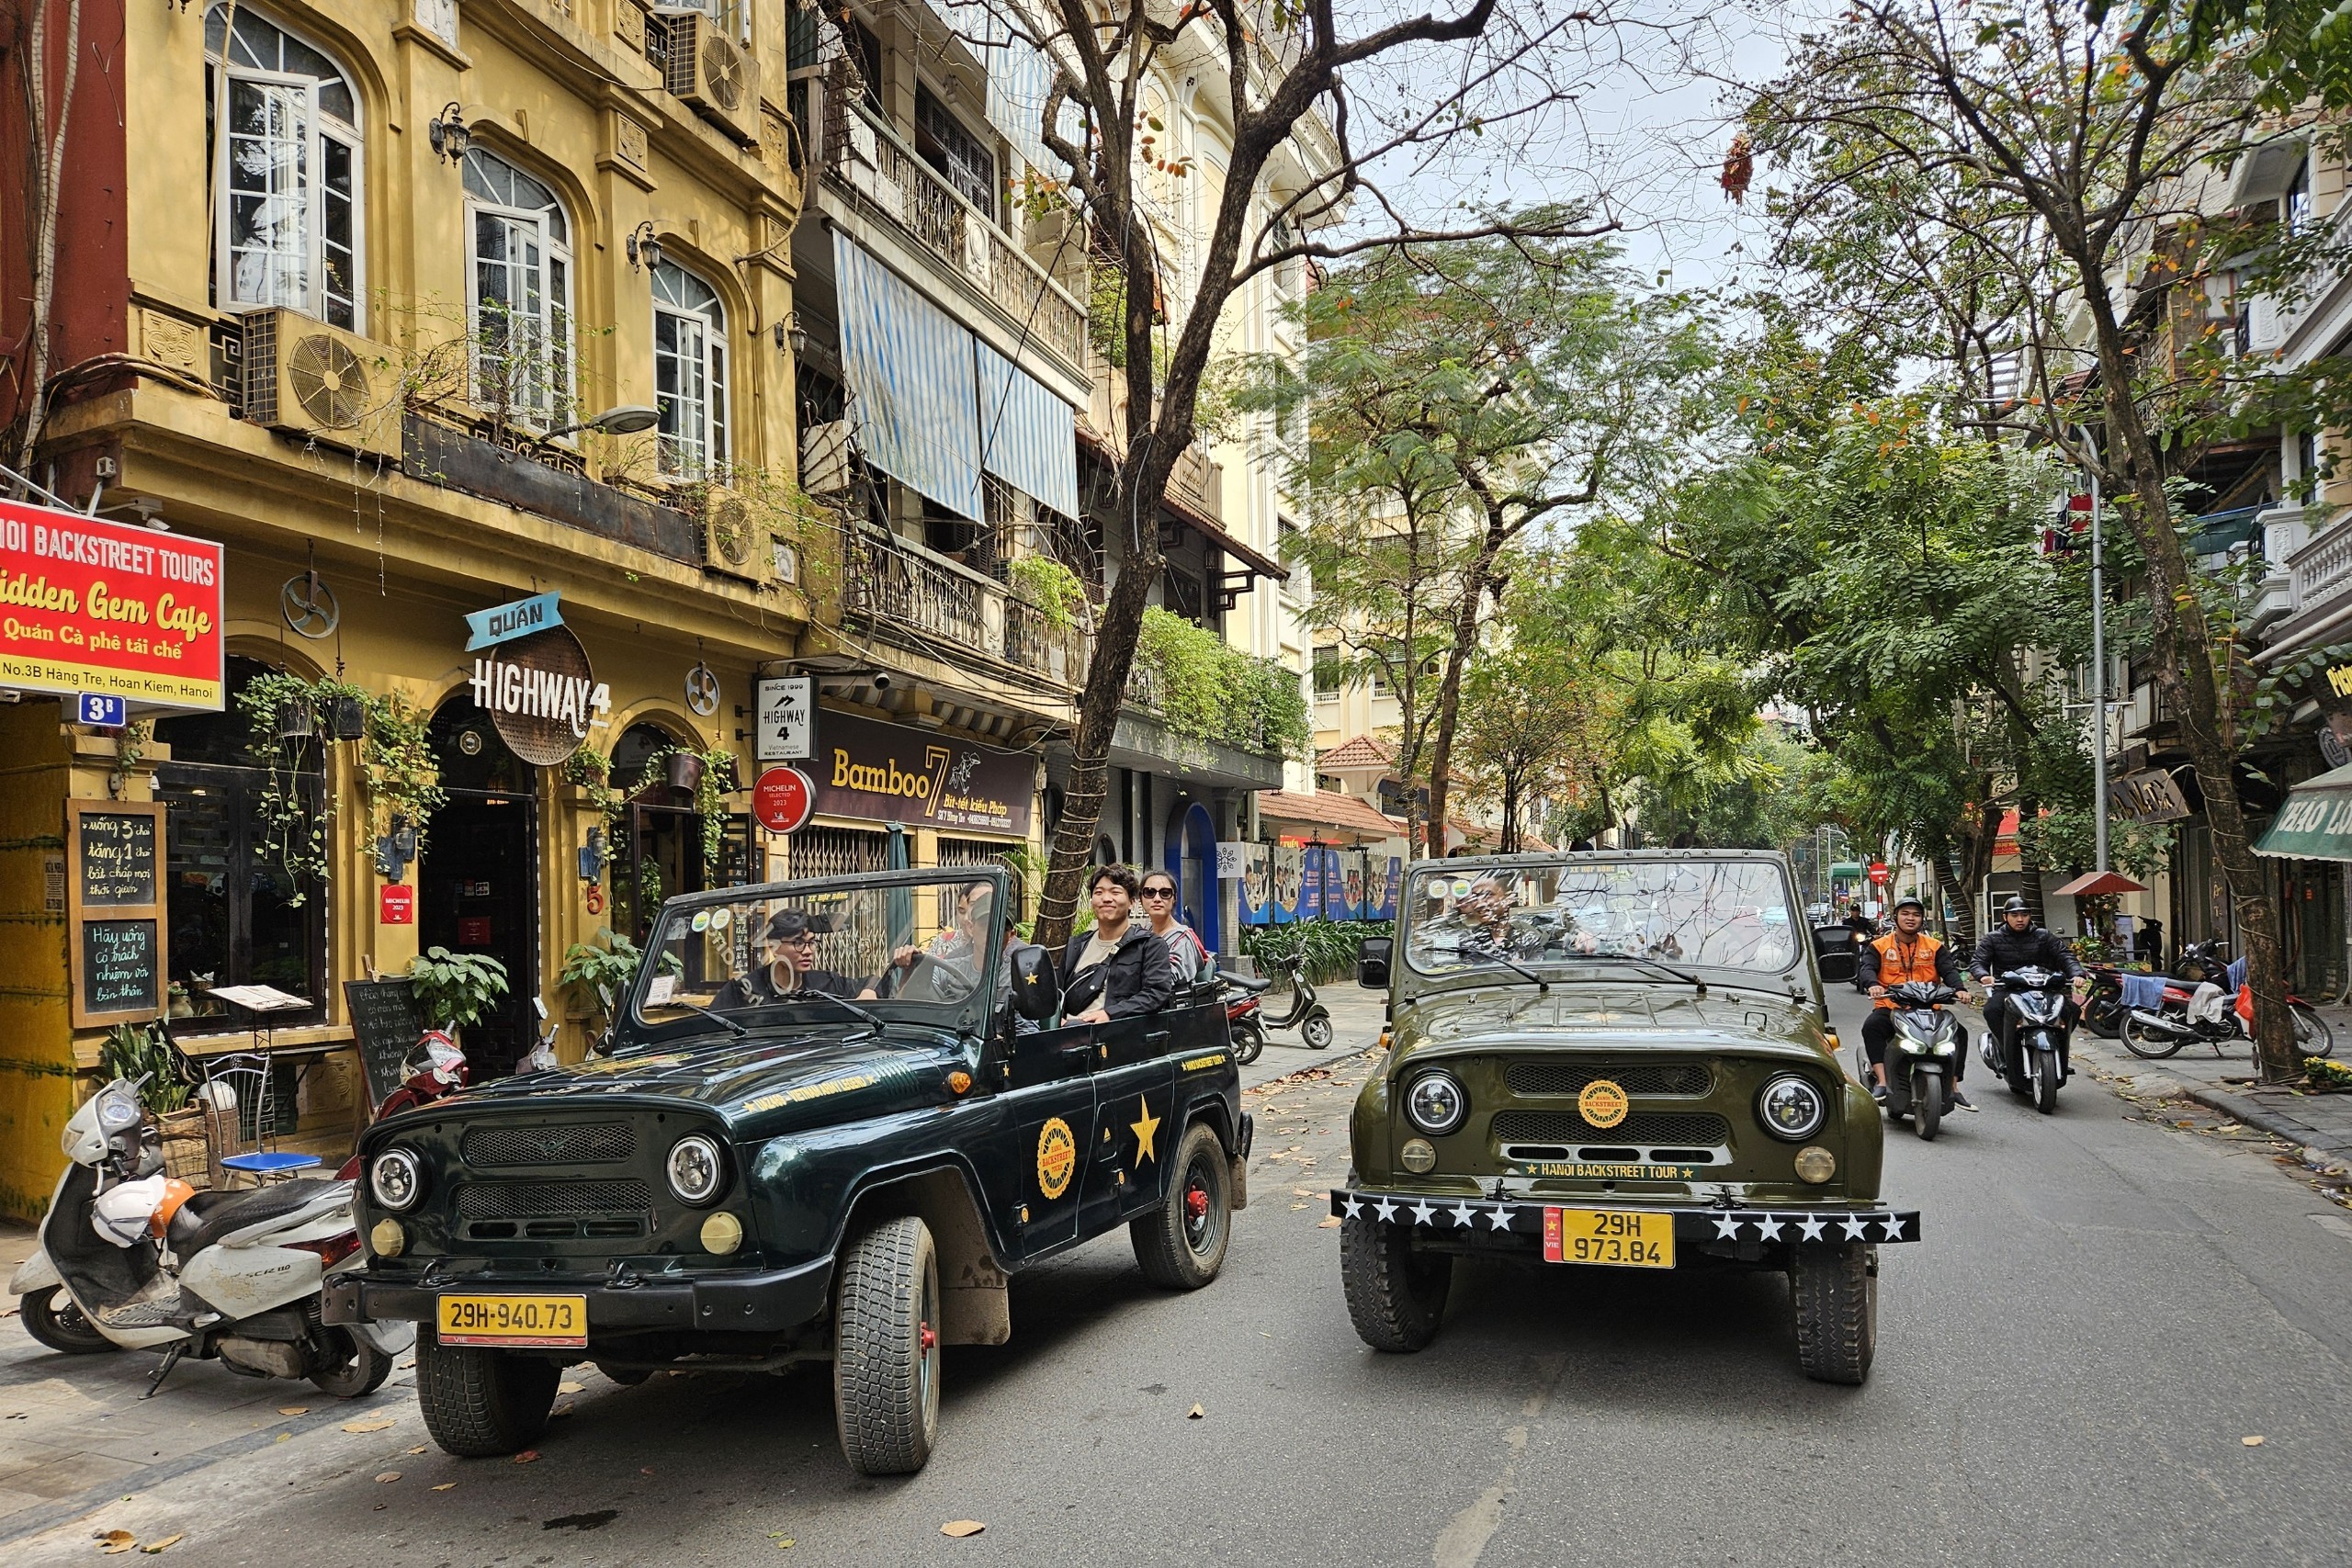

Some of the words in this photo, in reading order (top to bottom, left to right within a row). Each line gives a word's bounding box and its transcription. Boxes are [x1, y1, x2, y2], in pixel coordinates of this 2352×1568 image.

[34, 525, 154, 576] BACKSTREET
[159, 548, 214, 587] TOURS
[0, 569, 80, 614] idden
[86, 581, 150, 626] Gem
[156, 592, 213, 642] Cafe
[489, 602, 543, 637] QUÁN
[4, 617, 54, 642] Quán
[59, 626, 85, 646] Cà
[89, 631, 121, 652] phê
[126, 636, 149, 656] tái
[153, 641, 183, 660] chế
[3, 661, 42, 679] No.3B
[46, 667, 79, 686] Hàng
[83, 671, 106, 688] Tre,
[109, 675, 141, 690] Hoan
[144, 680, 176, 695] Kiem,
[180, 683, 213, 699] Hanoi
[764, 683, 786, 692] SINCE
[469, 658, 591, 739] HIGHWAY
[590, 682, 612, 715] 4
[763, 709, 806, 727] HIGHWAY
[776, 727, 790, 741] 4
[763, 784, 797, 793] MICHELIN
[831, 748, 929, 799] Bamboo
[924, 745, 950, 818] 7
[88, 817, 119, 838] uống
[122, 820, 133, 840] 3
[124, 843, 132, 860] 1
[587, 883, 604, 915] 5
[93, 926, 119, 949] Hãy
[122, 925, 145, 950] uống
[111, 945, 139, 962] trách
[786, 1084, 824, 1102] VIETNAM
[819, 1079, 842, 1096] ARMY
[837, 1076, 867, 1092] LEGEND
[1042, 1150, 1071, 1167] BACKSTREET
[1541, 1163, 1575, 1176] HANOI
[1577, 1165, 1645, 1178] BACKSTREET
[1648, 1166, 1678, 1179] TOUR
[1594, 1213, 1641, 1236] 29H
[1575, 1238, 1661, 1263] 973.84
[450, 1303, 572, 1329] 29H-940.73
